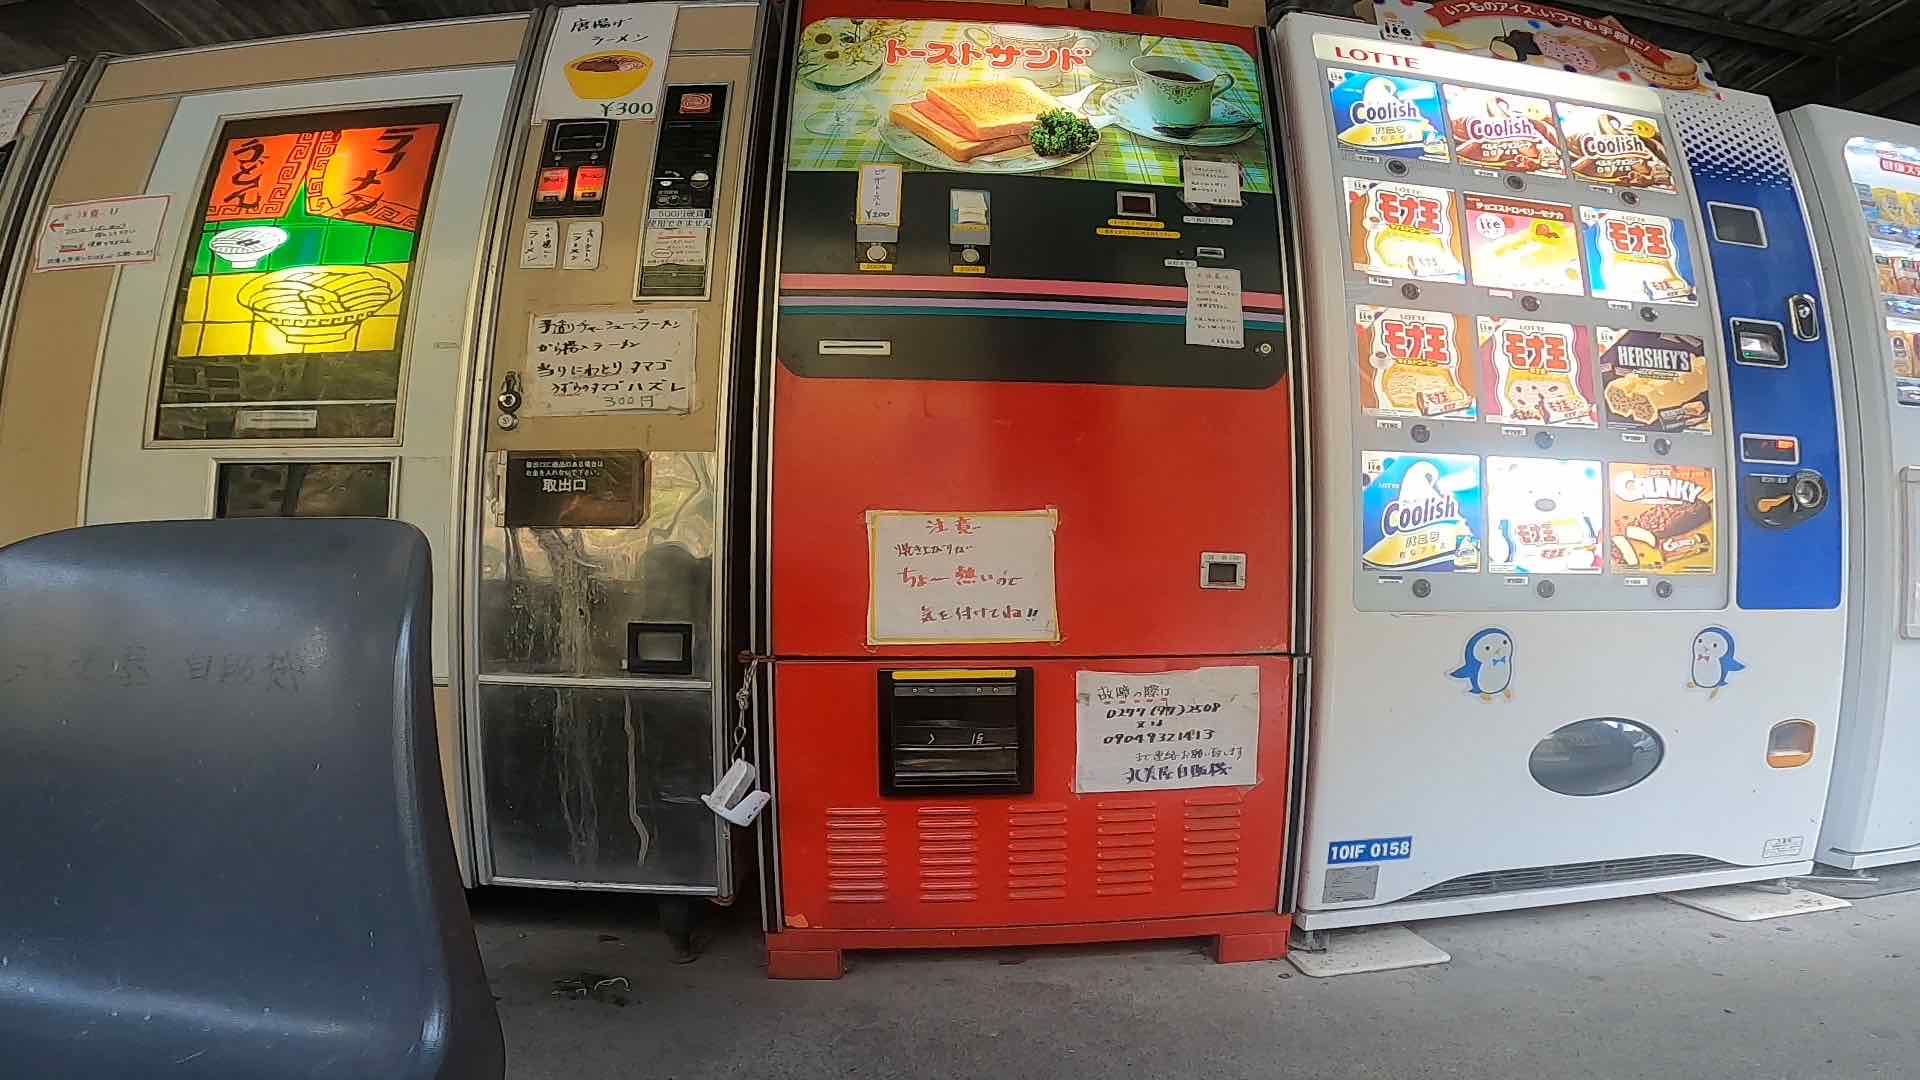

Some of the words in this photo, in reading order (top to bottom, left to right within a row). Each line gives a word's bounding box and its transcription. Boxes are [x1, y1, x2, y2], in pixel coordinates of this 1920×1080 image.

[591, 33, 649, 46] ラーメン
[885, 37, 1092, 71] トーストサンド
[1335, 46, 1421, 69] LOTTE
[1352, 101, 1417, 124] Coolish
[1470, 119, 1532, 139] Coolish
[1583, 135, 1644, 156] Coolish
[223, 139, 269, 209] うどん
[1379, 192, 1440, 232] モナ王
[1608, 220, 1669, 256] モナ王
[1384, 322, 1448, 363] モナ王
[1507, 332, 1568, 370] モナ王
[1617, 345, 1691, 372] HERSHEY'S
[604, 396, 654, 408] 300円
[542, 478, 587, 493] 取出口
[925, 516, 981, 535] 注意
[1383, 495, 1455, 536] Coolish
[1370, 841, 1410, 857] 0158
